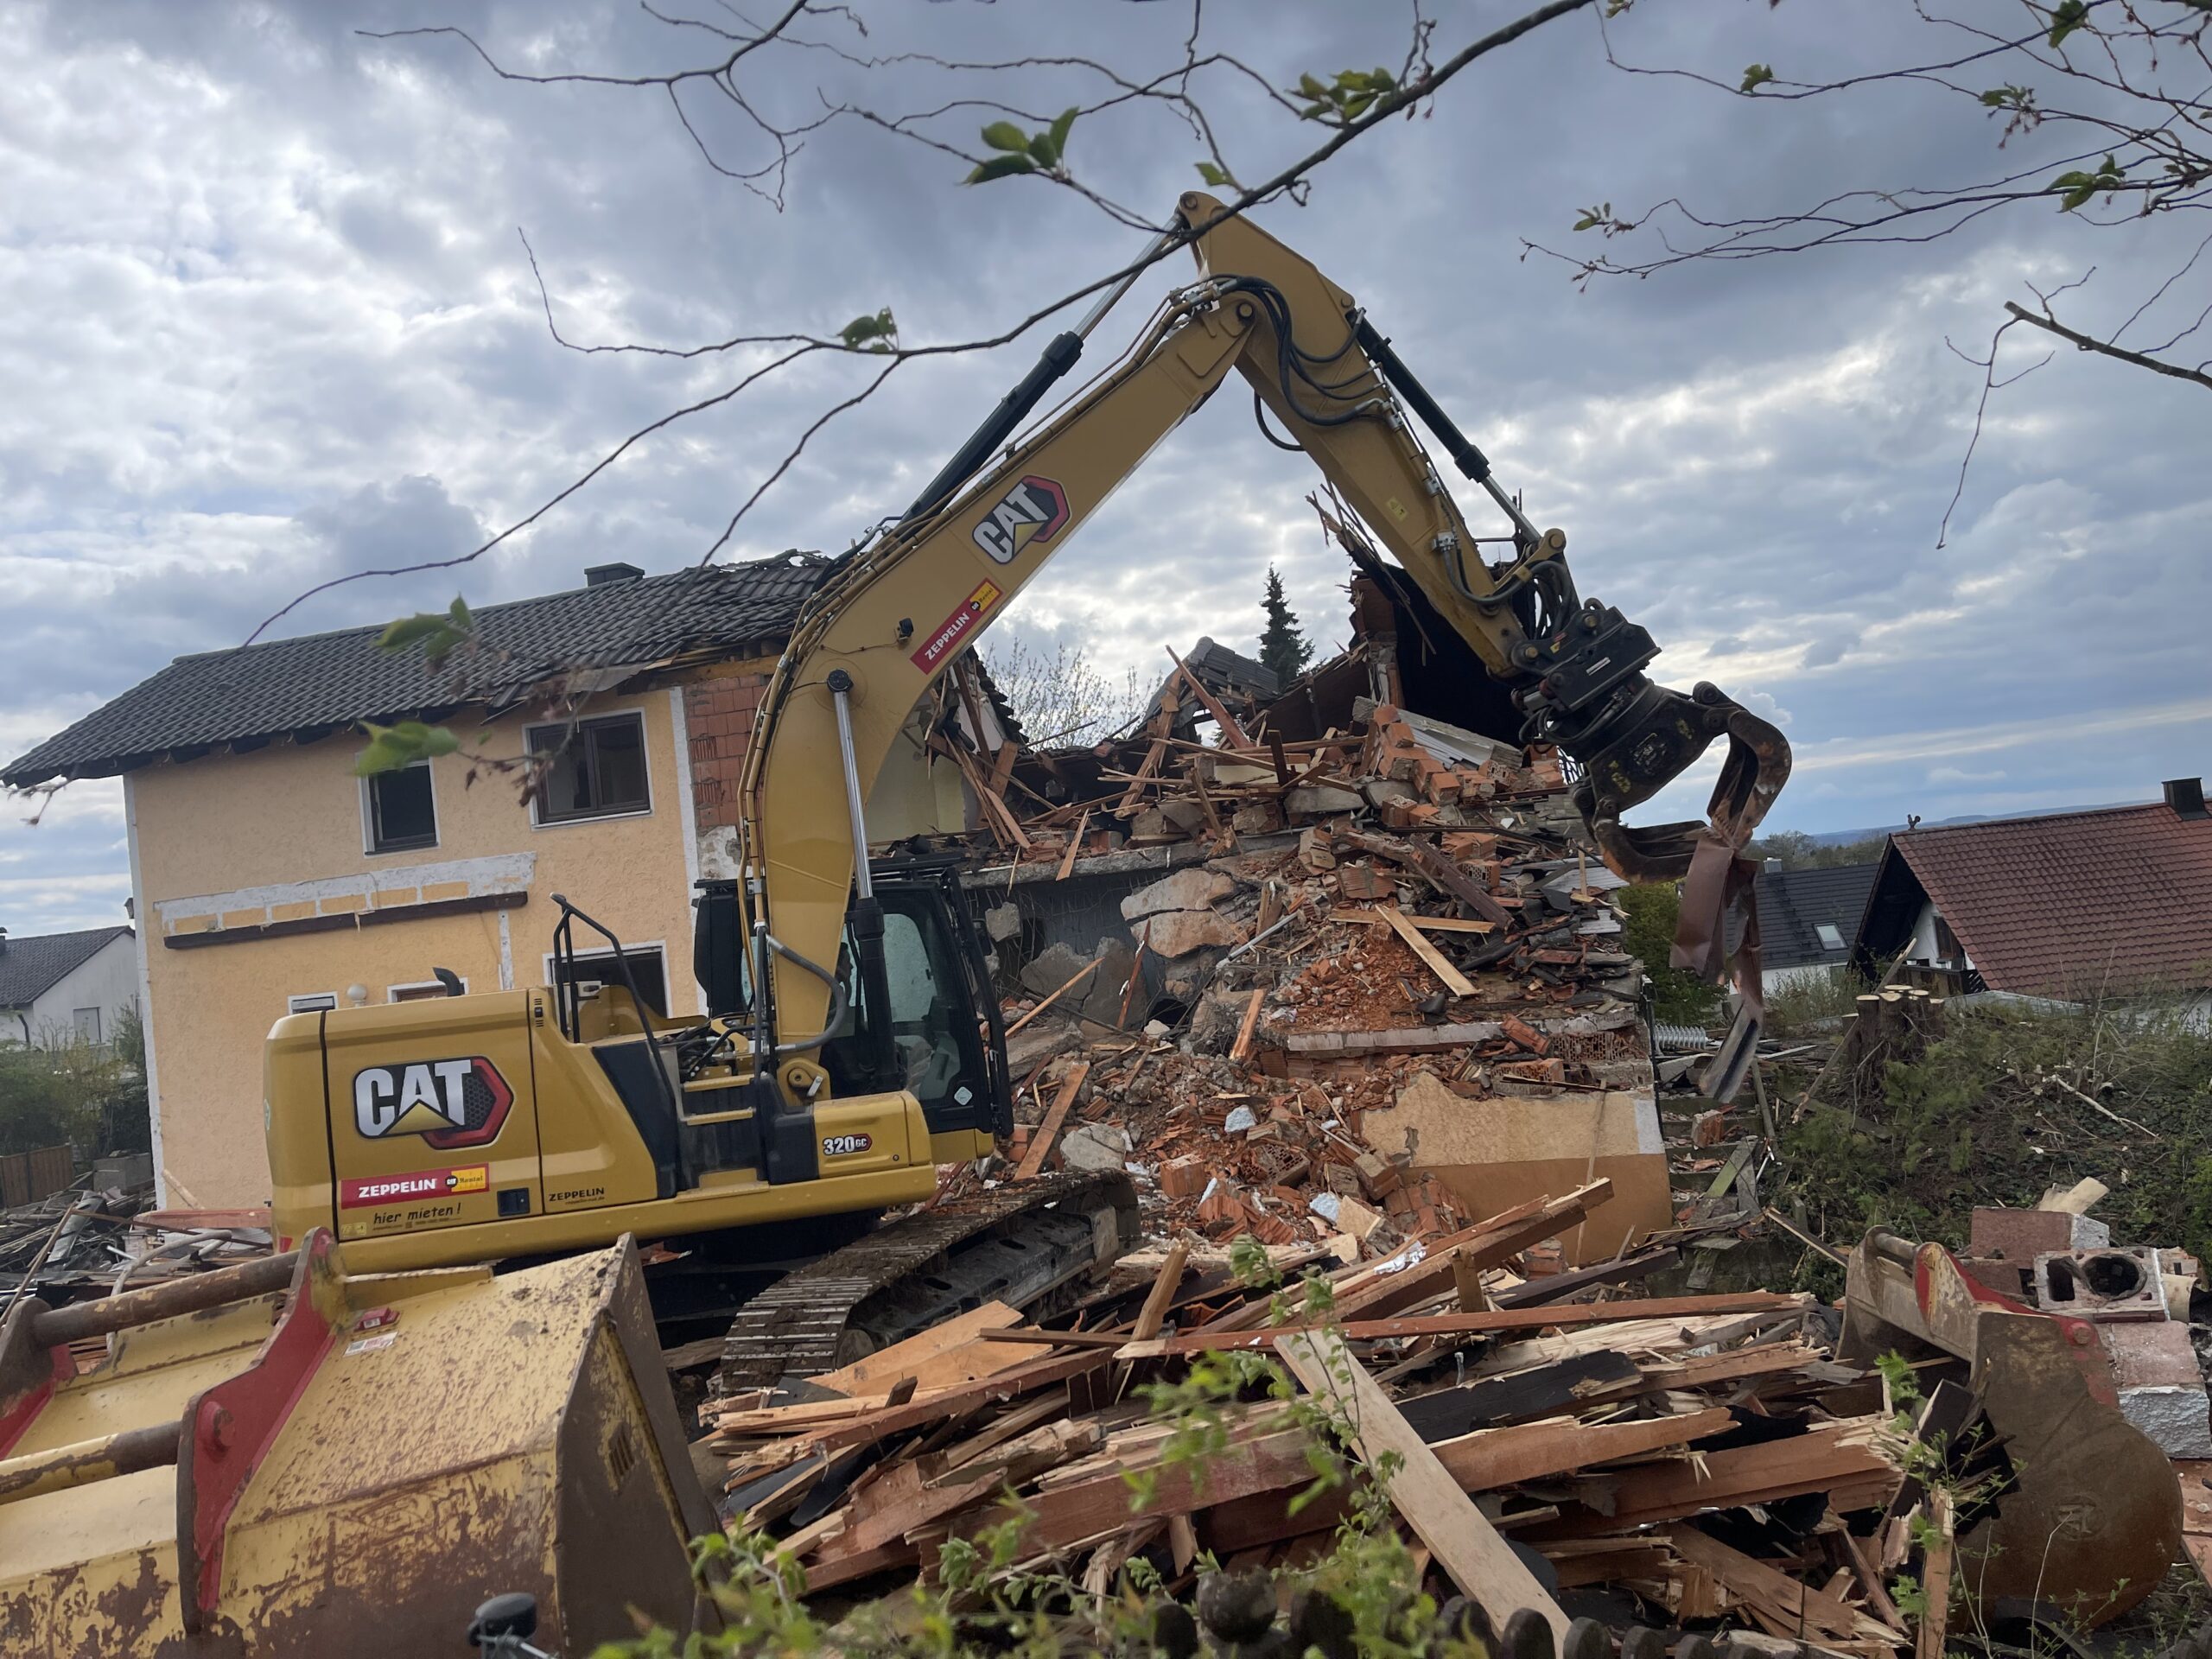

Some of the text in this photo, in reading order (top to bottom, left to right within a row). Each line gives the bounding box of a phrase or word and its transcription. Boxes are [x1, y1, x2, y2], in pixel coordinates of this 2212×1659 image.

[973, 482, 1049, 563] CAT
[925, 612, 969, 660] ZEPPELIN
[355, 1059, 472, 1136] CAT
[359, 1179, 436, 1198] ZEPPELIN
[549, 1186, 604, 1202] ZEPPELIN
[373, 1212, 401, 1224] hier
